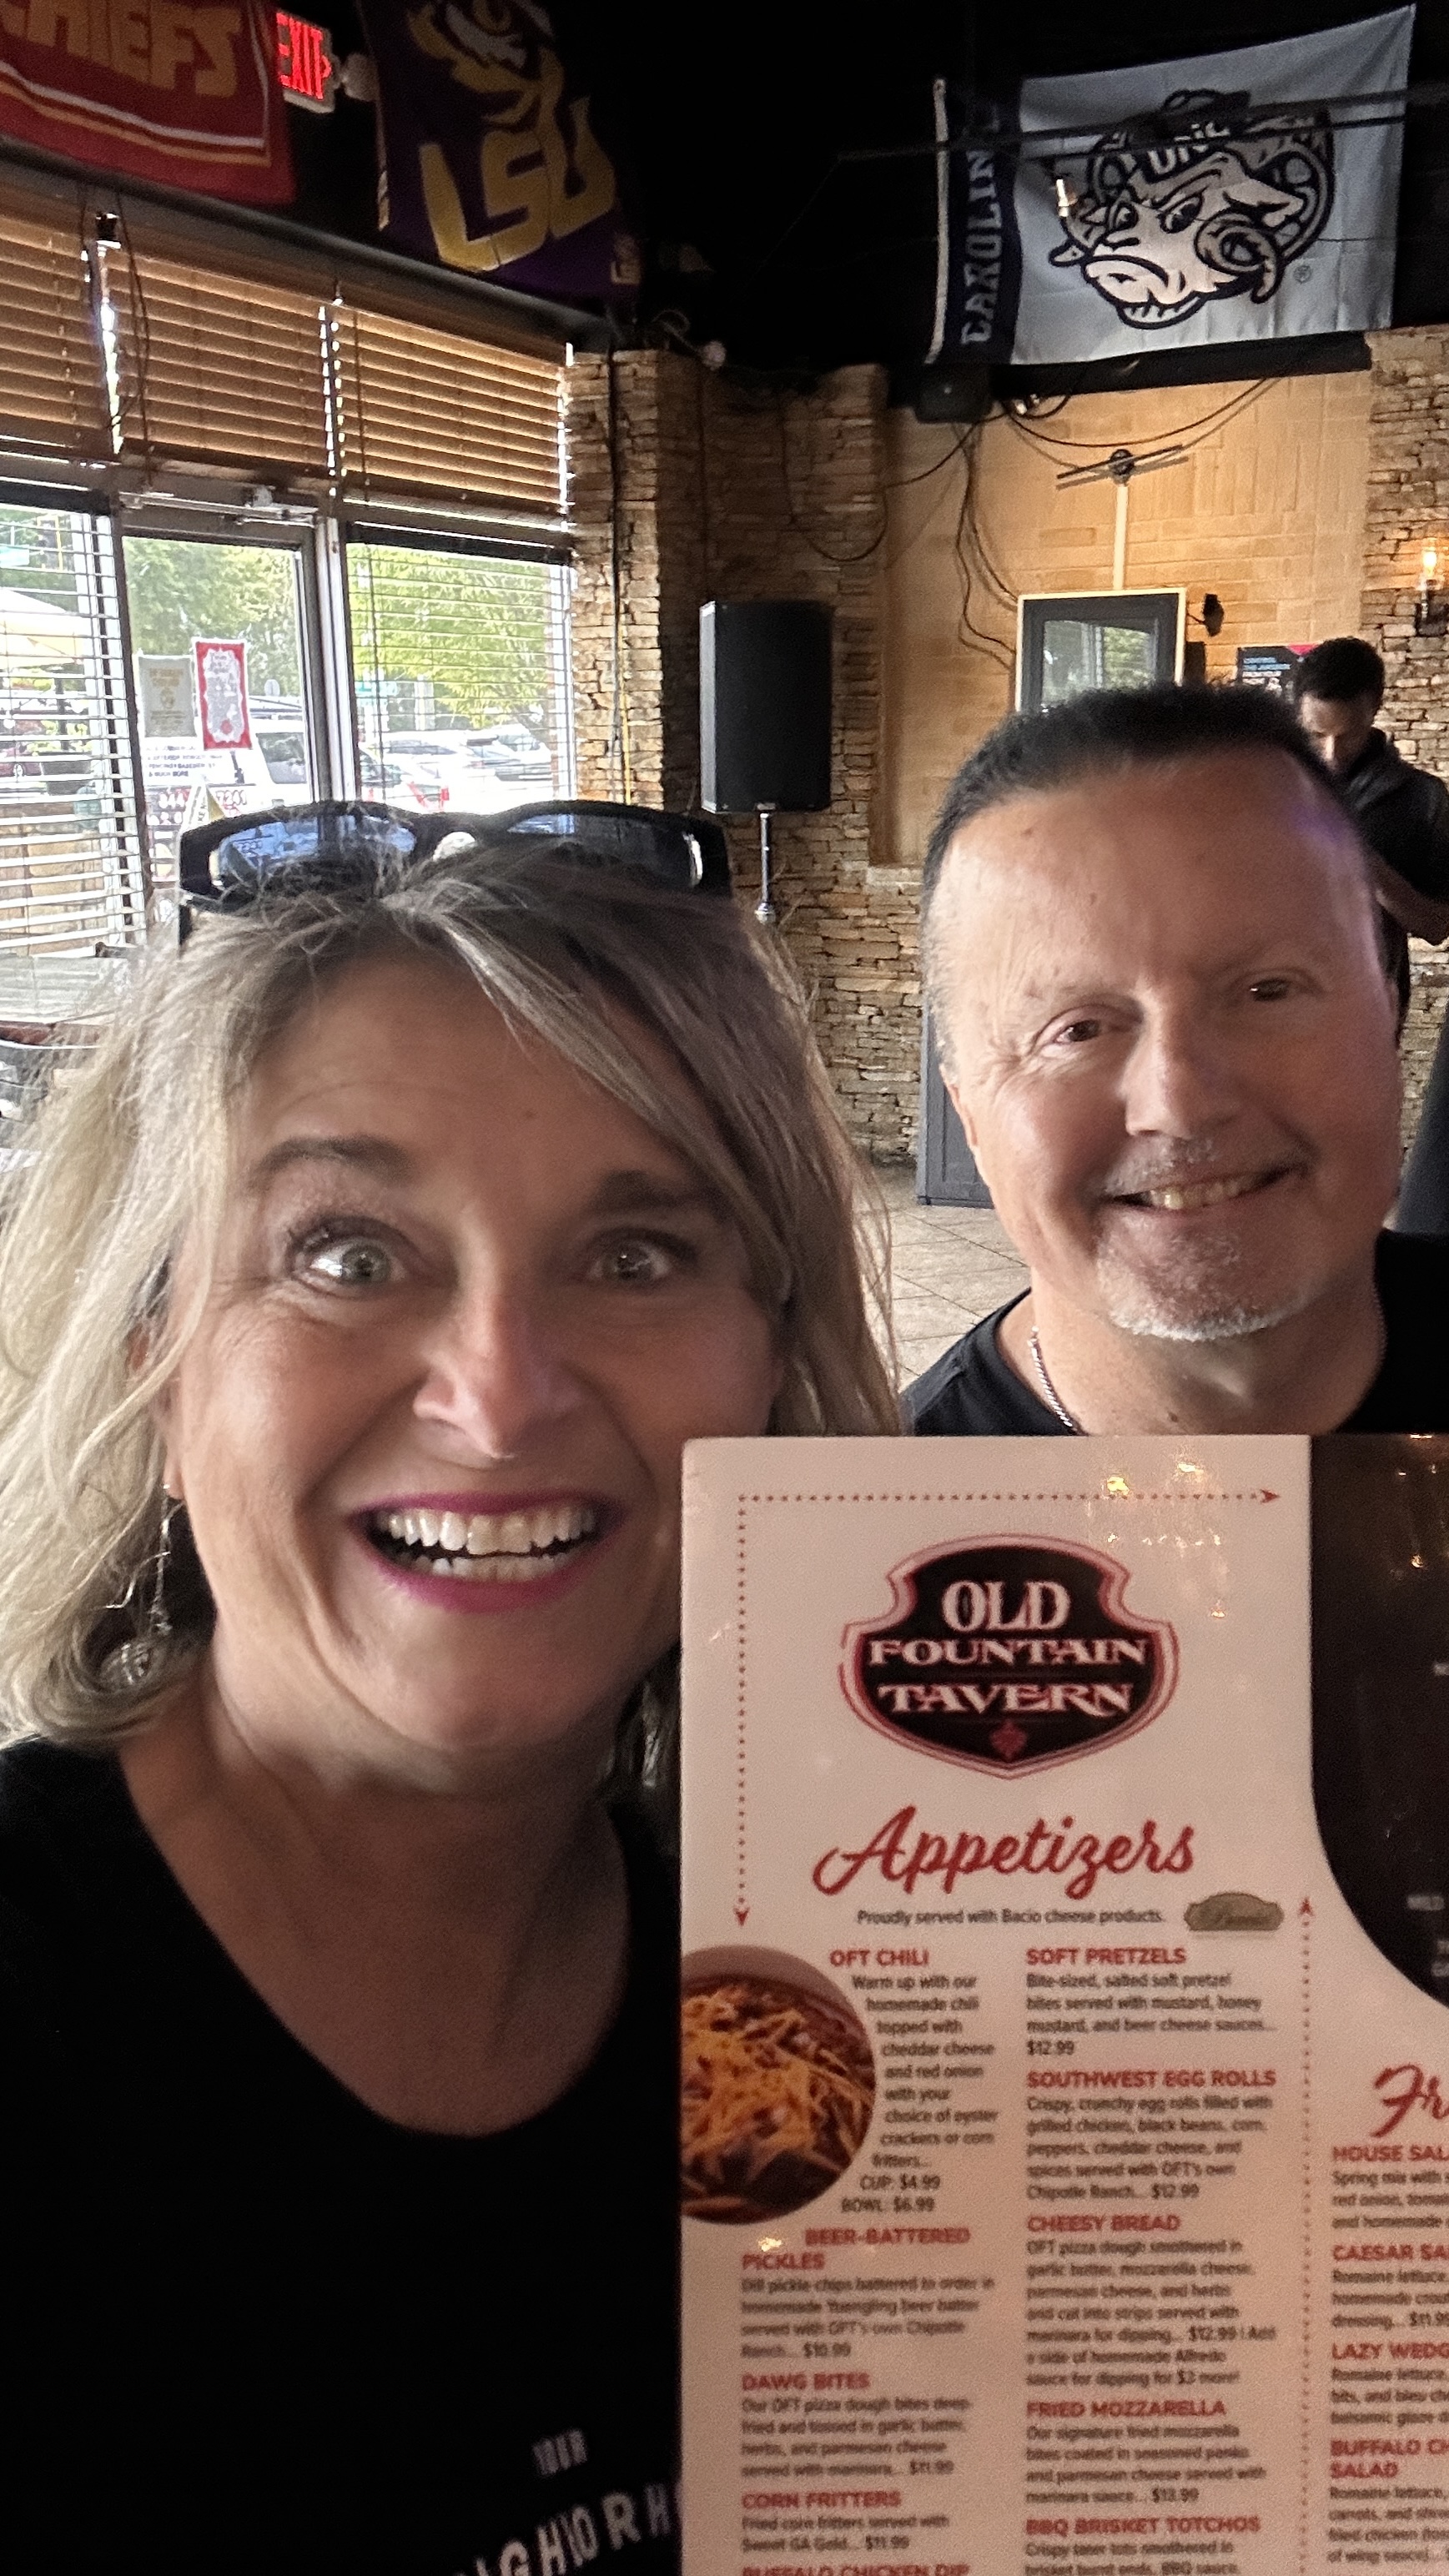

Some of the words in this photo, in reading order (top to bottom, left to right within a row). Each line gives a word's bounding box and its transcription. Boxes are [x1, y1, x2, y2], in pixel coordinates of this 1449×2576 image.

[0, 0, 242, 98] HIEFS
[276, 12, 325, 101] EXIT
[419, 97, 616, 273] LSU
[960, 103, 1004, 345] CAROLIN
[942, 1581, 1070, 1632] OLD
[869, 1639, 1147, 1665] FOUNTAIN
[878, 1683, 1133, 1718] TAVERN
[814, 1807, 1195, 1899] Appetizers
[858, 1909, 911, 1926] Proudly
[916, 1909, 964, 1924] served
[969, 1909, 996, 1924] with
[1002, 1908, 1041, 1924] Bacio
[1045, 1908, 1095, 1924] cheese
[1099, 1909, 1165, 1926] products.
[830, 1950, 870, 1968] OFT
[877, 1949, 929, 1967] CHILI
[1027, 1947, 1079, 1966] SOFT
[1085, 1946, 1185, 1965] PRETZELS
[853, 1975, 893, 1990] Warm
[897, 1977, 915, 1991] up
[919, 1975, 948, 1989] with
[953, 1975, 977, 1989] our
[1105, 1973, 1147, 1989] salted
[1152, 1972, 1177, 1987] soft
[1183, 1972, 1230, 1990] pretzel
[867, 1997, 946, 2011] homemade
[950, 1996, 979, 2010] chili
[1027, 1996, 1061, 2010] bites
[1065, 1995, 1112, 2010] served
[1118, 1995, 1146, 2010] with
[1218, 1995, 1261, 2012] honey
[878, 2020, 928, 2036] topped
[933, 2019, 962, 2034] with
[1093, 2018, 1119, 2032] and
[1124, 2017, 1156, 2031] beer
[1161, 2017, 1211, 2031] cheese
[943, 2041, 994, 2055] cheese
[1027, 2040, 1074, 2055] $12.99
[885, 2064, 913, 2079] and
[916, 2065, 941, 2078] red
[944, 2065, 984, 2078] onion
[1027, 2070, 1157, 2089] SOUTHWEST
[1163, 2070, 1205, 2088] EGG
[1211, 2069, 1275, 2087] ROLLS
[885, 2086, 915, 2101] with
[920, 2088, 951, 2103] your
[1372, 2063, 1449, 2138] Fr
[1139, 2098, 1165, 2114] egg
[1243, 2096, 1271, 2109] with
[885, 2109, 931, 2124] choice
[935, 2109, 951, 2123] of
[944, 2132, 959, 2145] or
[963, 2131, 994, 2145] corn
[1215, 2141, 1241, 2156] and
[1333, 2145, 1403, 2162] HOUSE
[1409, 2144, 1449, 2162] SAL
[1076, 2164, 1124, 2177] served
[1129, 2162, 1157, 2176] with
[1206, 2165, 1235, 2176] own
[1411, 2171, 1441, 2184] with
[900, 2174, 941, 2189] $4.99
[1151, 2183, 1199, 2198] $12.99
[893, 2196, 934, 2211] $6.99
[1028, 2214, 1105, 2232] CHEESY
[1111, 2214, 1180, 2232] BREAD
[806, 2227, 971, 2246] BEER-BATTERED
[742, 2252, 824, 2270] PICKLES
[1333, 2244, 1413, 2262] CAESAR
[1421, 2243, 1449, 2261] SA
[1188, 2326, 1236, 2341] $12.99
[1332, 2343, 1382, 2361] LAZY
[742, 2372, 807, 2391] DAWG
[814, 2372, 870, 2390] BITES
[1027, 2400, 1085, 2418] FRIED
[1091, 2399, 1225, 2418] MOZZARELLA
[1331, 2439, 1421, 2458] BUFFALO
[1331, 2461, 1398, 2479] SALAD
[742, 2492, 798, 2509] CORN
[807, 2489, 901, 2508] FRITTERS
[1027, 2518, 1068, 2538] BBQ
[1075, 2517, 1158, 2535] BRISKET
[1166, 2515, 1260, 2533] TOTCHOS
